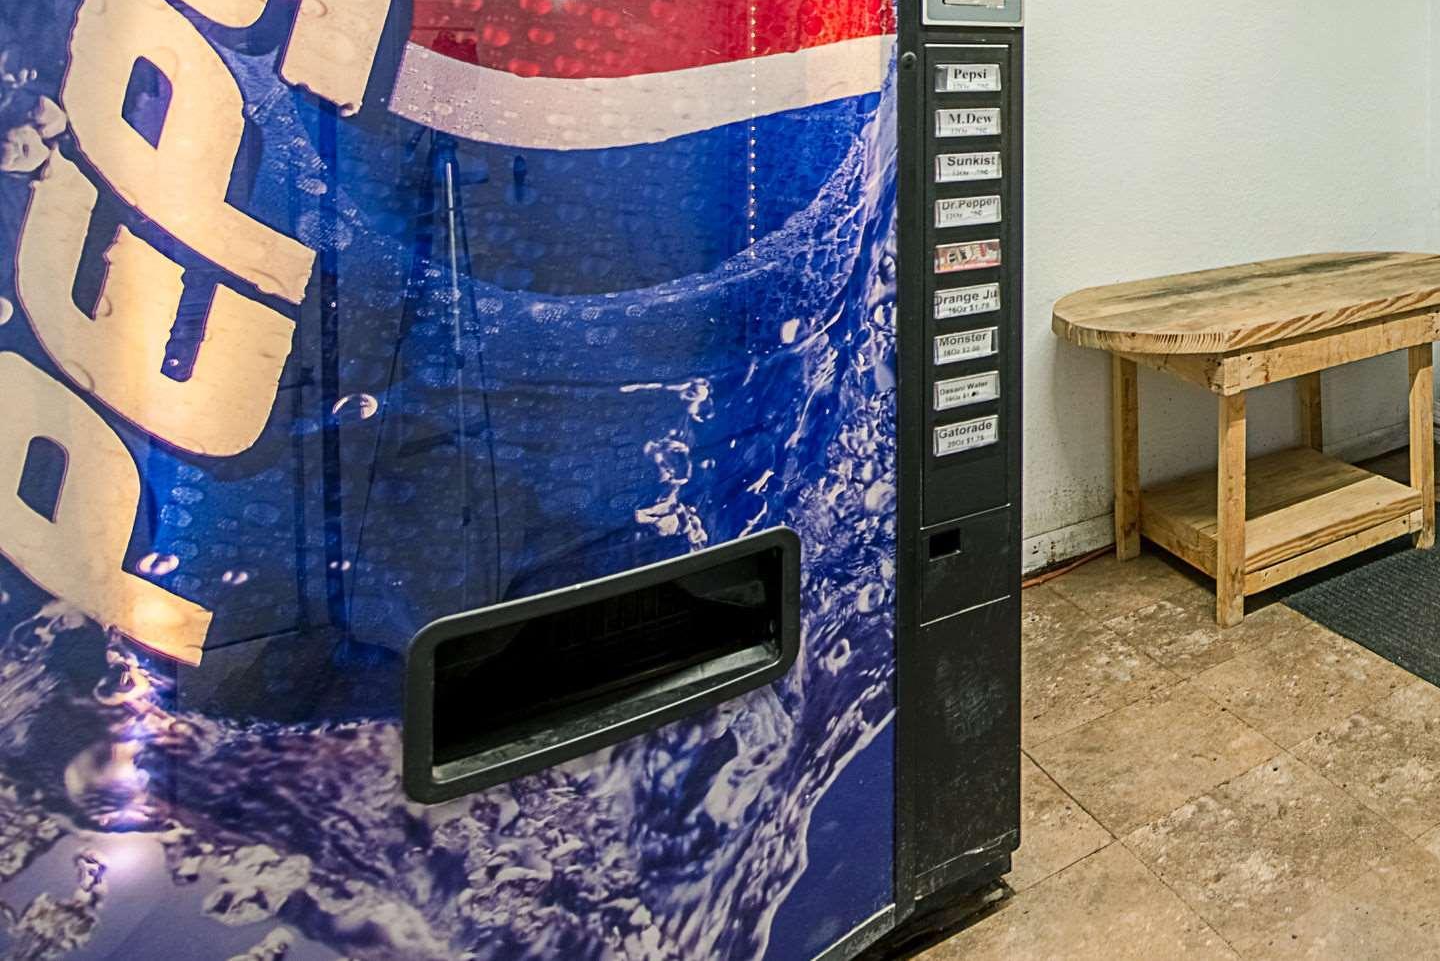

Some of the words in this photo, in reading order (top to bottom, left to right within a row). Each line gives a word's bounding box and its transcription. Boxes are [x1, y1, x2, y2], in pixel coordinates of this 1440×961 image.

[953, 68, 987, 83] Pepsi
[948, 112, 992, 124] M.Dew
[946, 154, 996, 167] Sunkist
[939, 333, 988, 347] Monster
[939, 421, 993, 439] Gatorade
